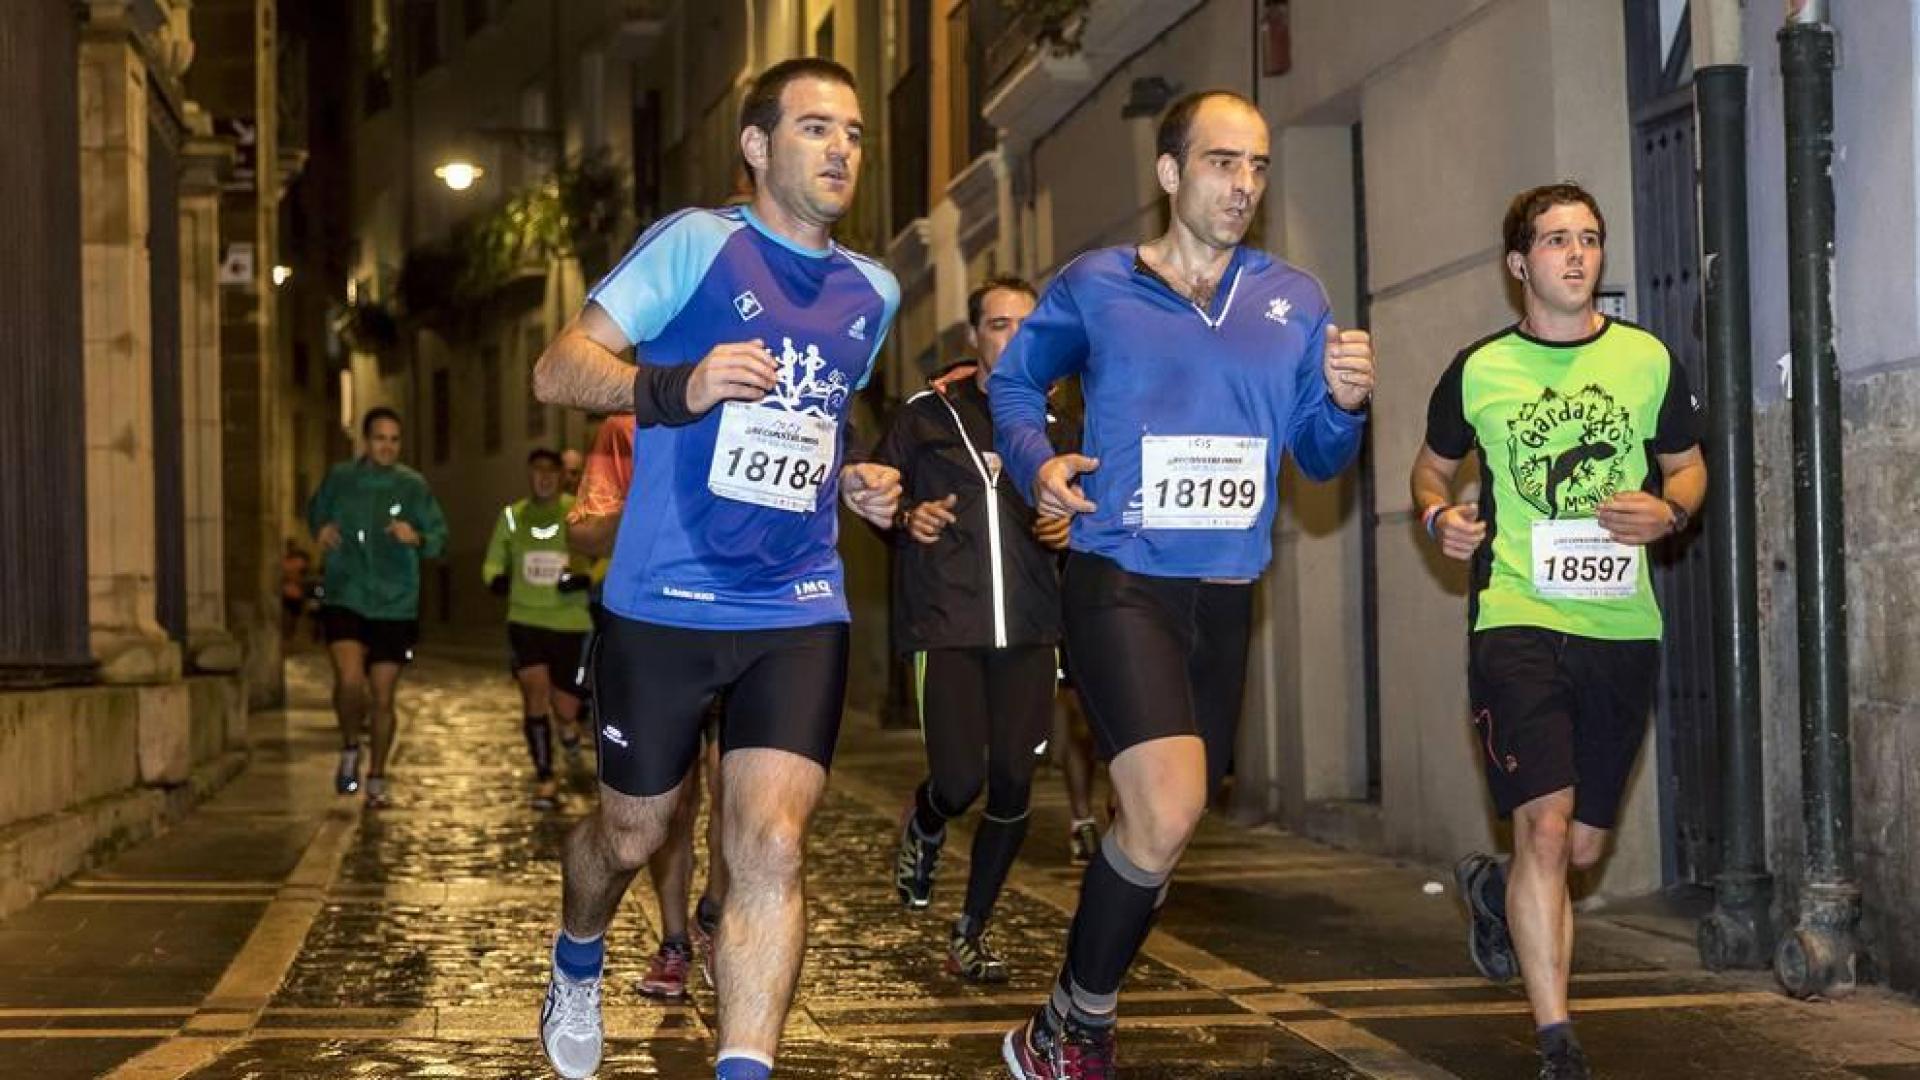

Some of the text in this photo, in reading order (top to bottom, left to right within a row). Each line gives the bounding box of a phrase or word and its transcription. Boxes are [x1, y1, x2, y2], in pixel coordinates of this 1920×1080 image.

[728, 447, 827, 490] 18184
[1155, 478, 1256, 509] 18199
[1543, 556, 1632, 582] 18597
